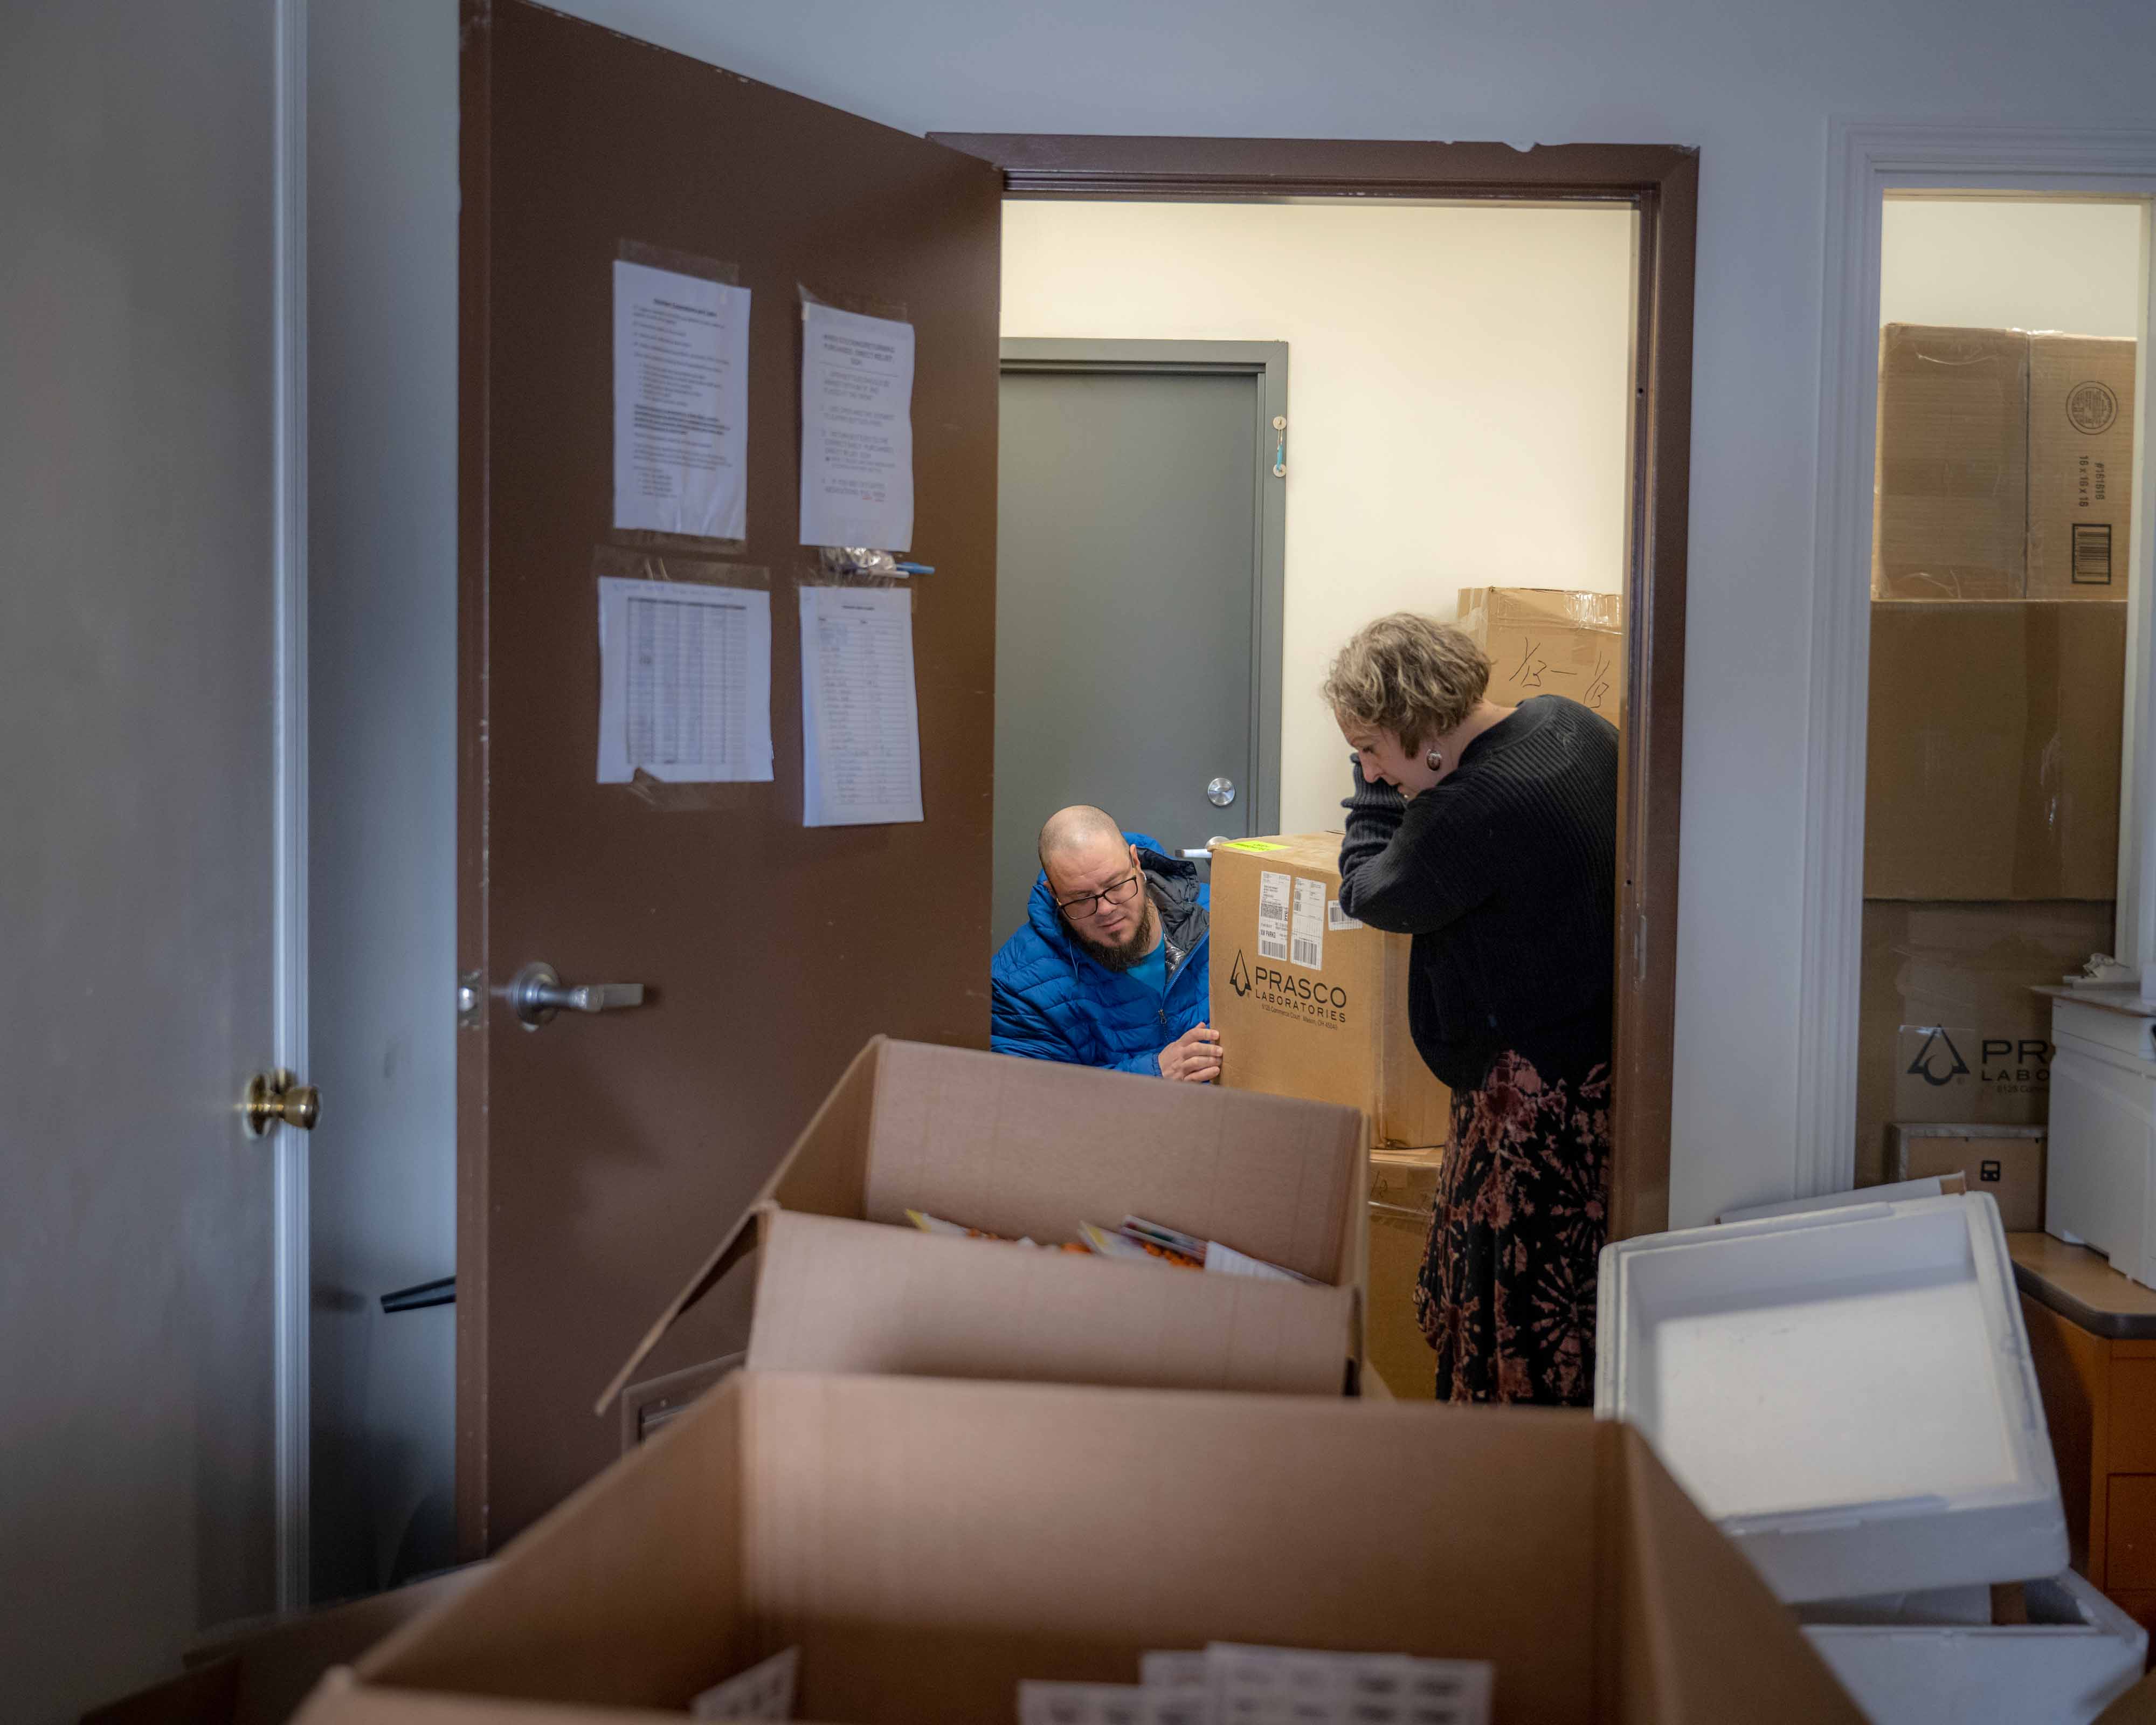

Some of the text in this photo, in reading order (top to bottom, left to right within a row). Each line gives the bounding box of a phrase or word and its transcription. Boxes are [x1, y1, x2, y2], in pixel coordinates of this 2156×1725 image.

[1255, 966, 1347, 1009] PRASCO
[1255, 989, 1346, 1023] LABORATORIES
[1982, 1040, 2049, 1064] PR
[1981, 1069, 2050, 1081] LABO
